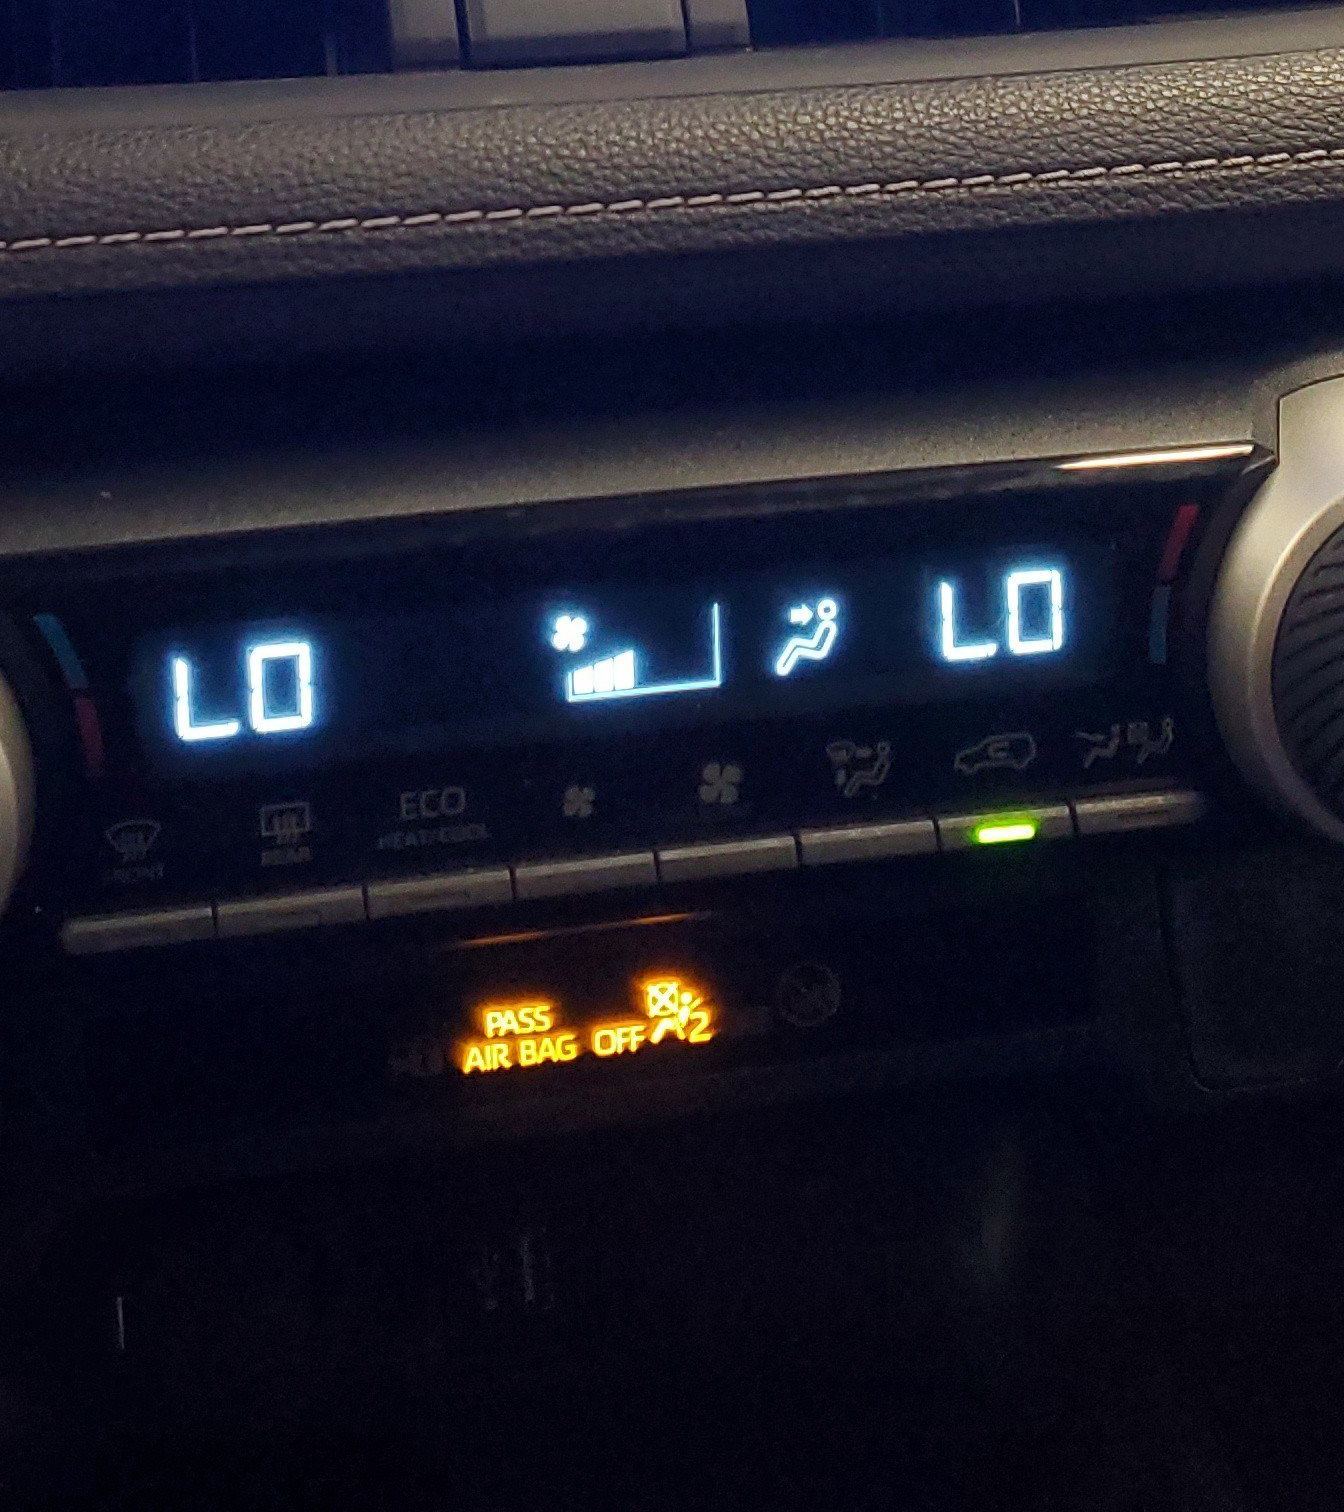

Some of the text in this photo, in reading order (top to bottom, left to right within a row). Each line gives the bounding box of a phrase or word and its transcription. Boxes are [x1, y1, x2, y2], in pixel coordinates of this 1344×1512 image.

[940, 569, 1063, 663] LO
[173, 642, 314, 741] LO
[399, 787, 466, 820] ECO
[484, 1005, 553, 1038] PASS
[461, 1042, 513, 1075] AIR
[519, 1034, 577, 1067] BAG
[592, 1023, 645, 1058] OFF
